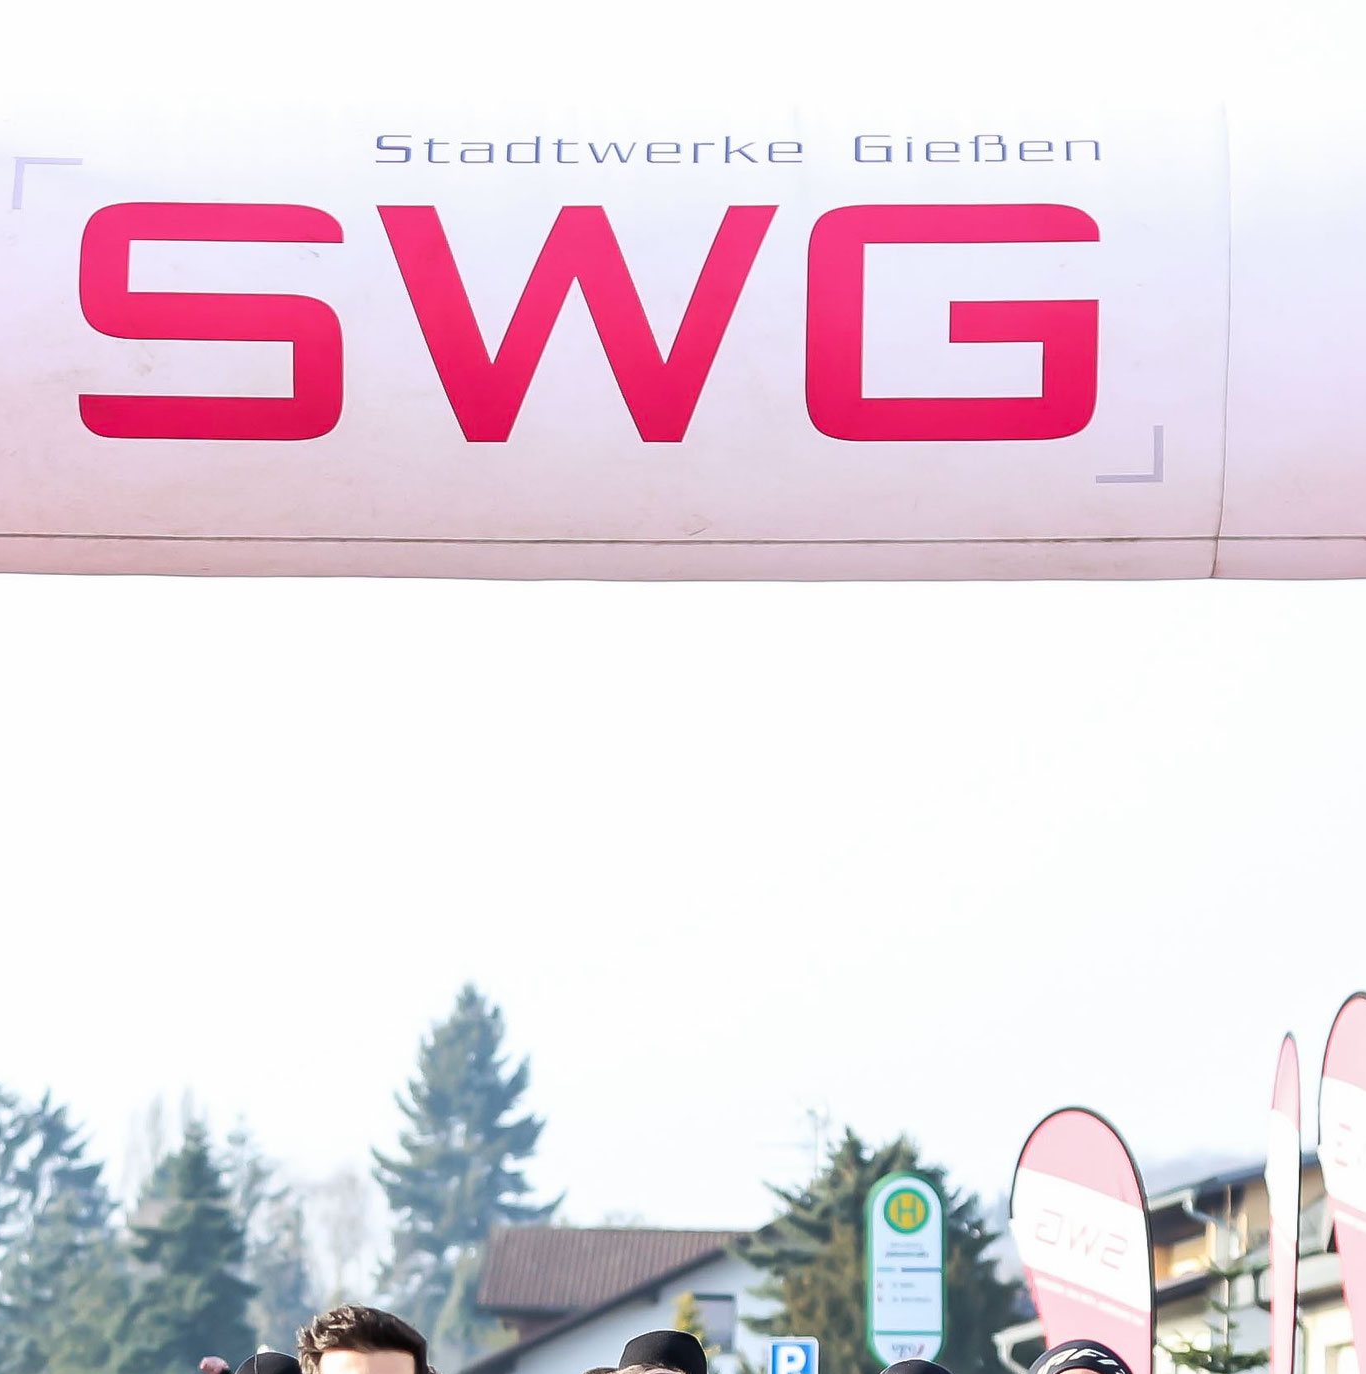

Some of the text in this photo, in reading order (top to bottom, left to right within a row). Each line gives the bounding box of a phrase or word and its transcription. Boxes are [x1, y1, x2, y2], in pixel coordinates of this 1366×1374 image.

[376, 134, 1101, 164] Stadtwerke Gießen
[78, 201, 1100, 443] SWG
